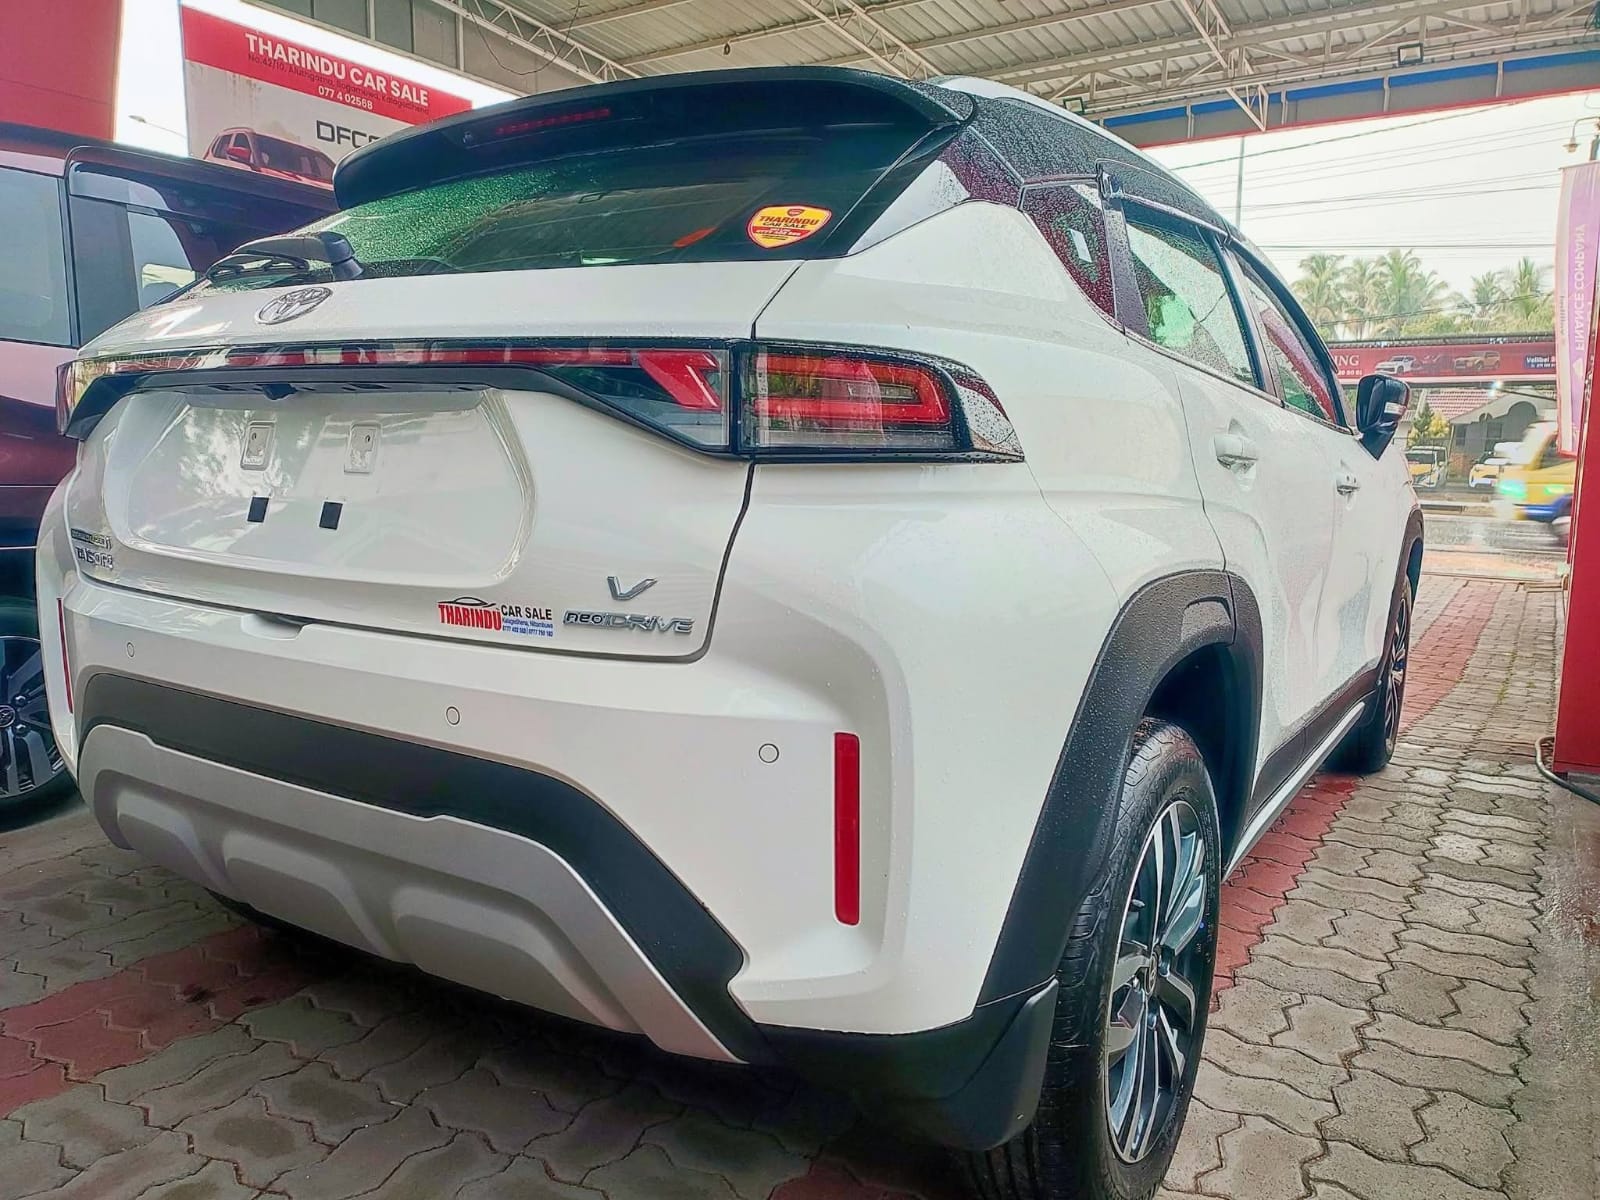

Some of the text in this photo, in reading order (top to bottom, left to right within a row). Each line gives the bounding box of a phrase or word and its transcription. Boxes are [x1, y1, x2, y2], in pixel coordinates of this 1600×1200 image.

[245, 33, 429, 107] THARINDU CAR SALE
[318, 85, 335, 99] 077
[759, 216, 819, 226] THARINDU
[606, 575, 658, 601] V
[438, 604, 502, 632] THARINDU
[501, 604, 553, 621] CAR SALE
